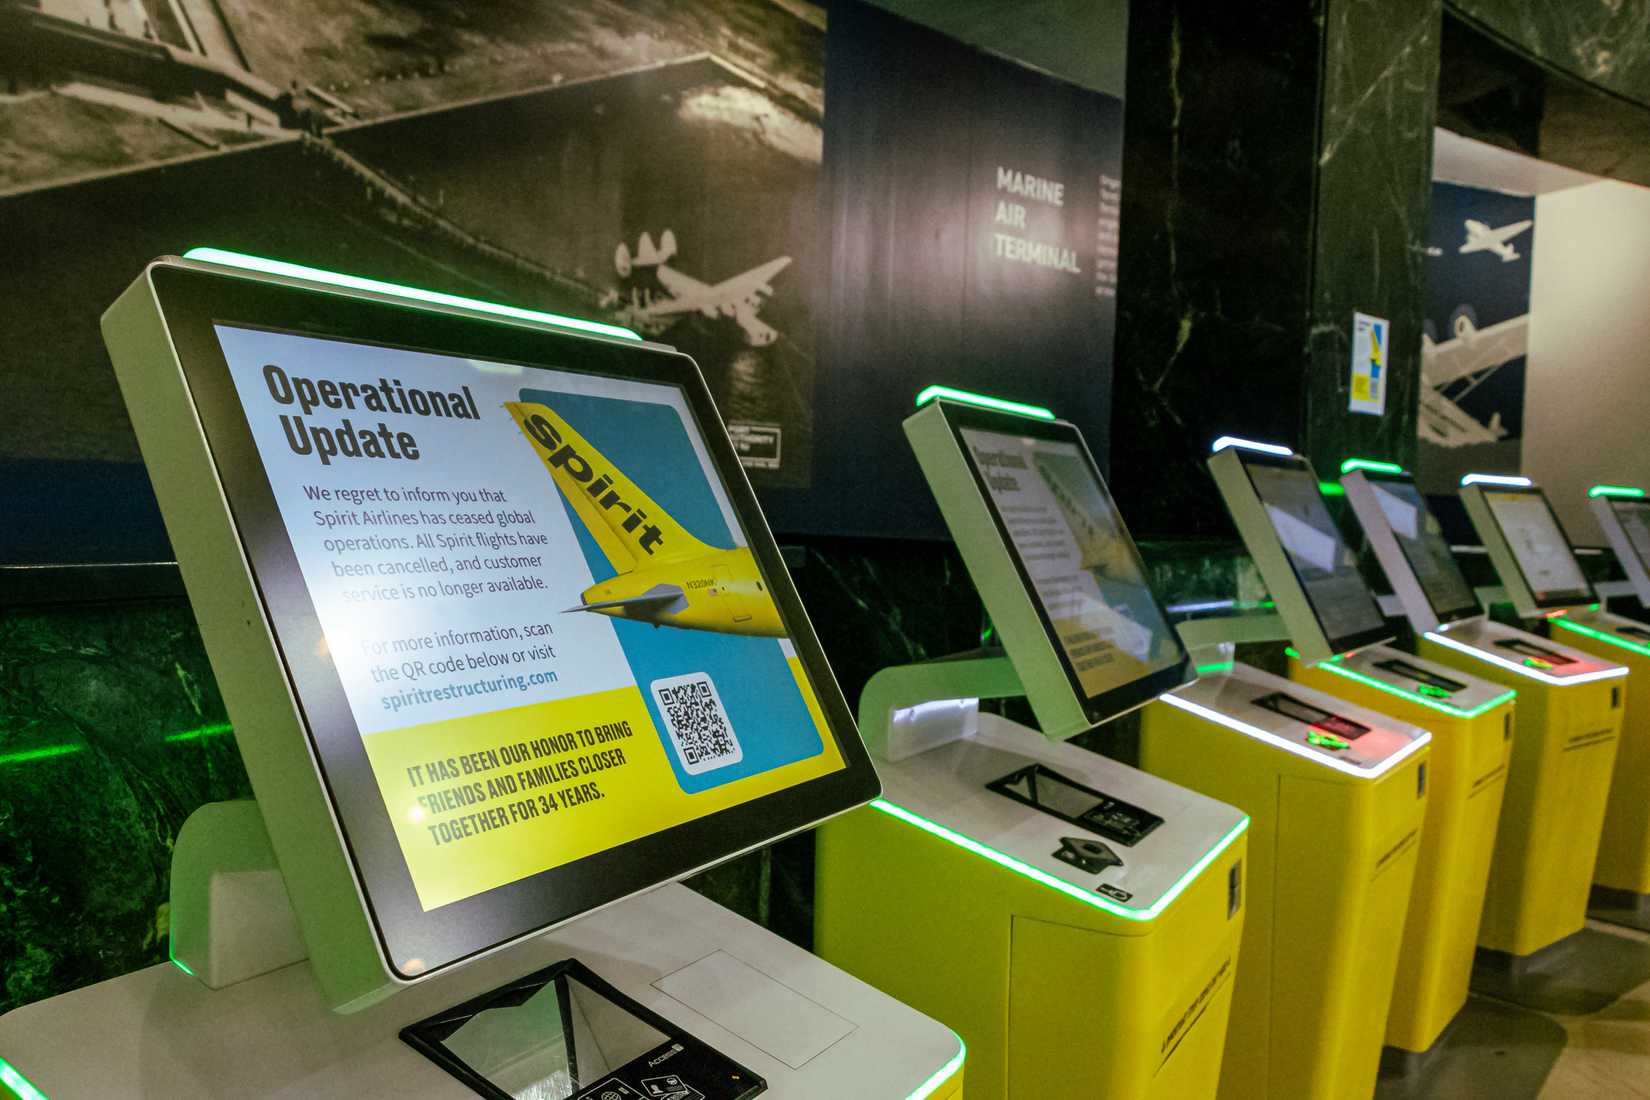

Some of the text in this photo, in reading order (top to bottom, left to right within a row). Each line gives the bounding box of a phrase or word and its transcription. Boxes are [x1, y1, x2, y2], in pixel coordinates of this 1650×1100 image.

[997, 166, 1065, 208] MARINE
[995, 201, 1027, 230] AIR
[993, 233, 1082, 274] TERMINAL
[262, 364, 481, 420] Operational
[278, 414, 421, 466] Update
[303, 485, 508, 506] We regret to inform you that
[523, 413, 664, 556] Spirit
[313, 510, 537, 530] Spirit Airlines has ceased global
[323, 531, 549, 556] operations. All Spirit flights have
[331, 555, 543, 577] been cancelled, and customer
[342, 575, 549, 602] service is no longer available.
[360, 623, 555, 657] For more information, scan
[370, 643, 557, 684] the QR code below or visit
[381, 671, 559, 712] spiritrestructuring.com
[406, 720, 634, 788] IT HAS BEEN OUR HONOR TO BRING
[485, 774, 518, 800] AND
[516, 759, 580, 792] FAMILIES
[577, 747, 627, 776] CLOSER
[427, 781, 606, 847] TOGETHER FOR 34 YEARS.
